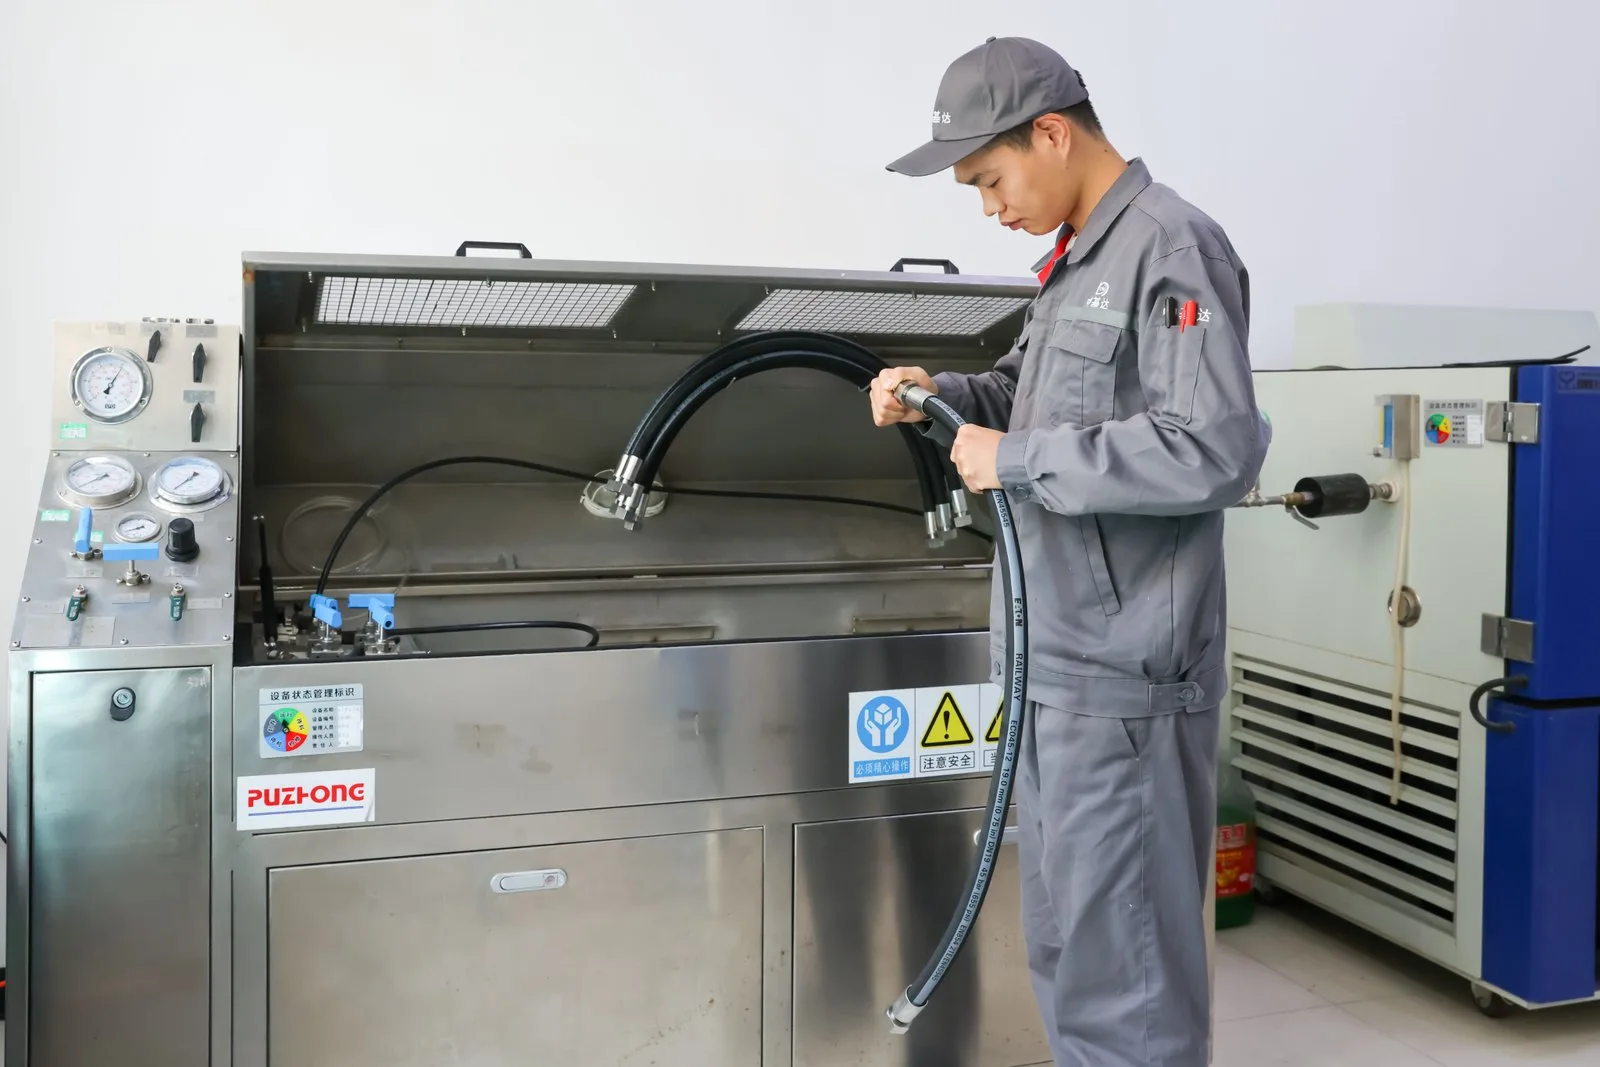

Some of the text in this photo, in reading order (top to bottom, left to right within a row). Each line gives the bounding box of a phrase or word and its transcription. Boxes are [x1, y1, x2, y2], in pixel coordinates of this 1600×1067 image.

[1013, 653, 1023, 702] RAILWAY
[270, 687, 355, 701] 设备状态管理标识
[855, 760, 909, 775] 必须精心操作
[923, 754, 972, 770] 注意安全
[1000, 768, 1010, 786] 19.0
[997, 788, 1005, 804] mm
[983, 841, 995, 863] DN19
[979, 867, 988, 878] 45
[975, 879, 984, 891] bar
